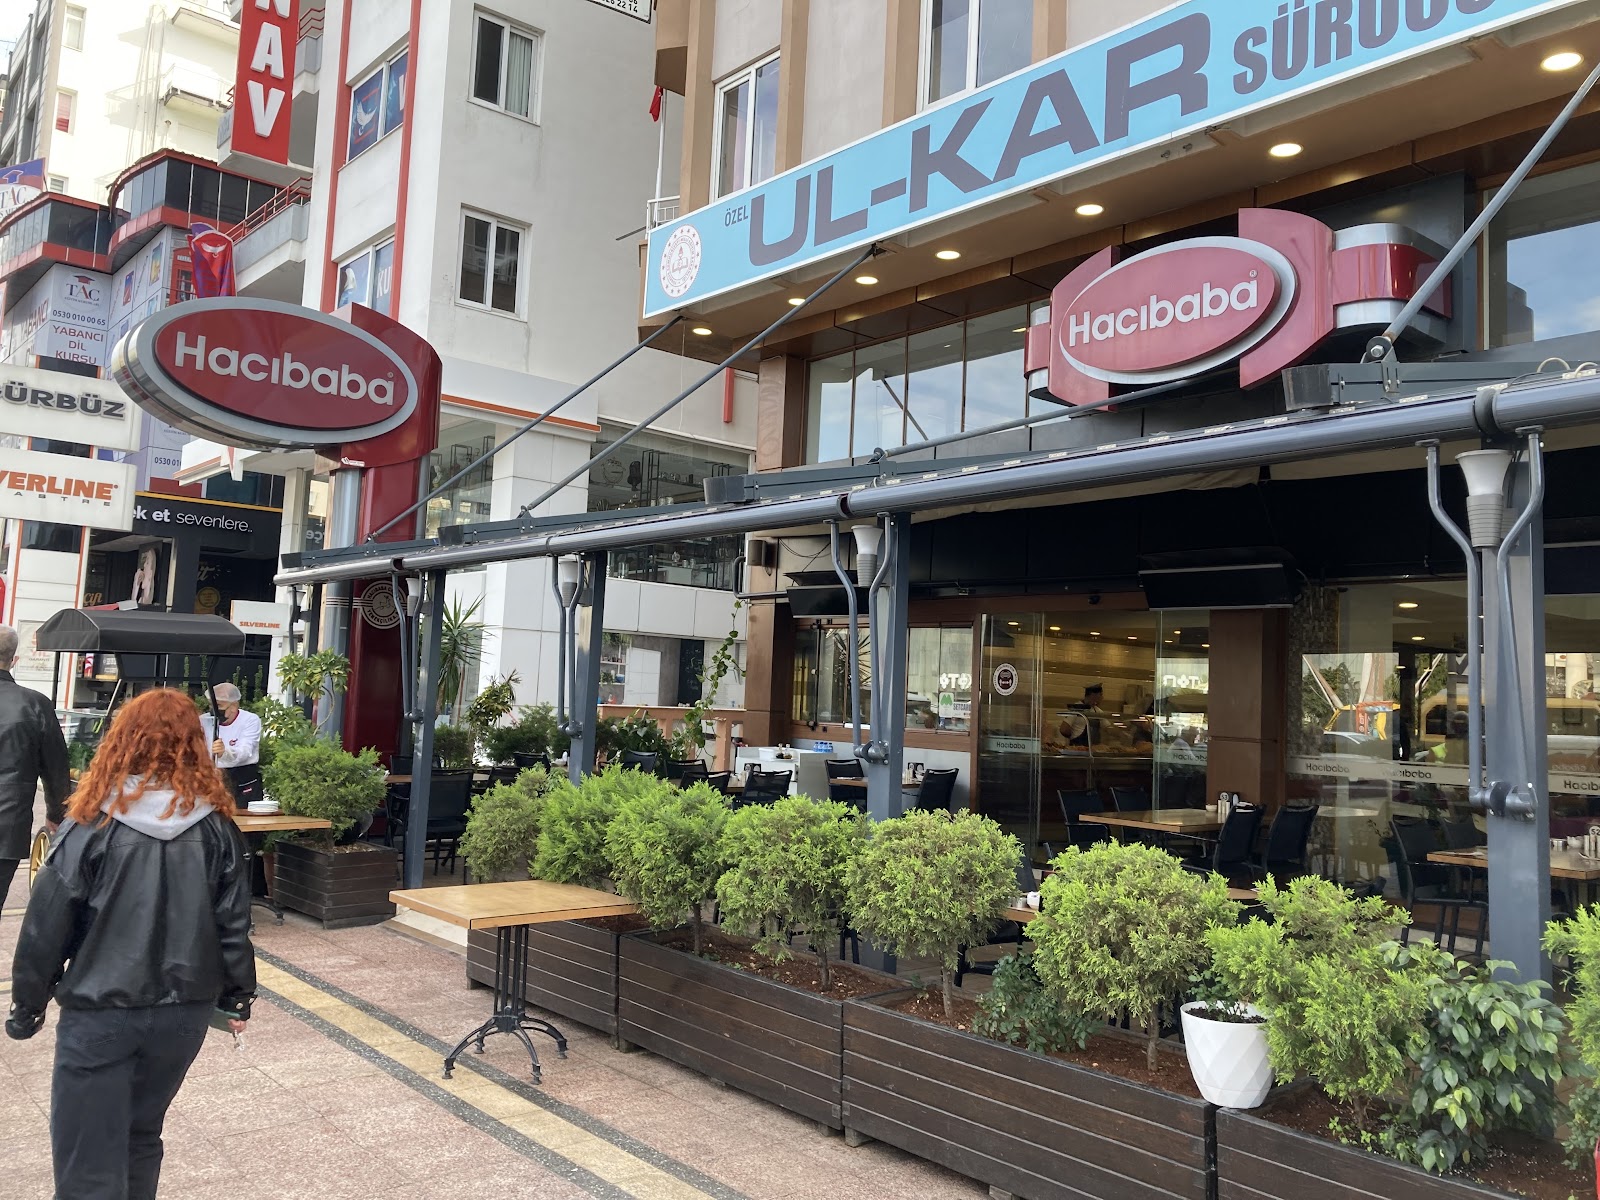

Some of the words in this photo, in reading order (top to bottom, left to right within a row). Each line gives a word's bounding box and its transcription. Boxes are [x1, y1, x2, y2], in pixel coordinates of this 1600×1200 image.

[628, 4, 638, 13] 14
[724, 205, 749, 227] ÖZEL
[749, 12, 1211, 266] UL-KAR
[376, 265, 392, 298] KU
[66, 283, 100, 302] TAC
[53, 310, 71, 319] 0530
[72, 313, 86, 322] 010
[87, 316, 96, 324] 00
[97, 318, 106, 326] 65
[53, 325, 104, 342] YABANCI
[68, 340, 87, 351] DİL
[56, 350, 97, 365] KURSU
[0, 380, 125, 420] ÜRBÜZ
[154, 457, 171, 466] 0530
[172, 459, 182, 467] 01
[152, 509, 171, 522] et
[176, 512, 253, 533] sevenlere..
[240, 621, 281, 629] SILVERLINE
[1305, 762, 1349, 773] Hacıbaba
